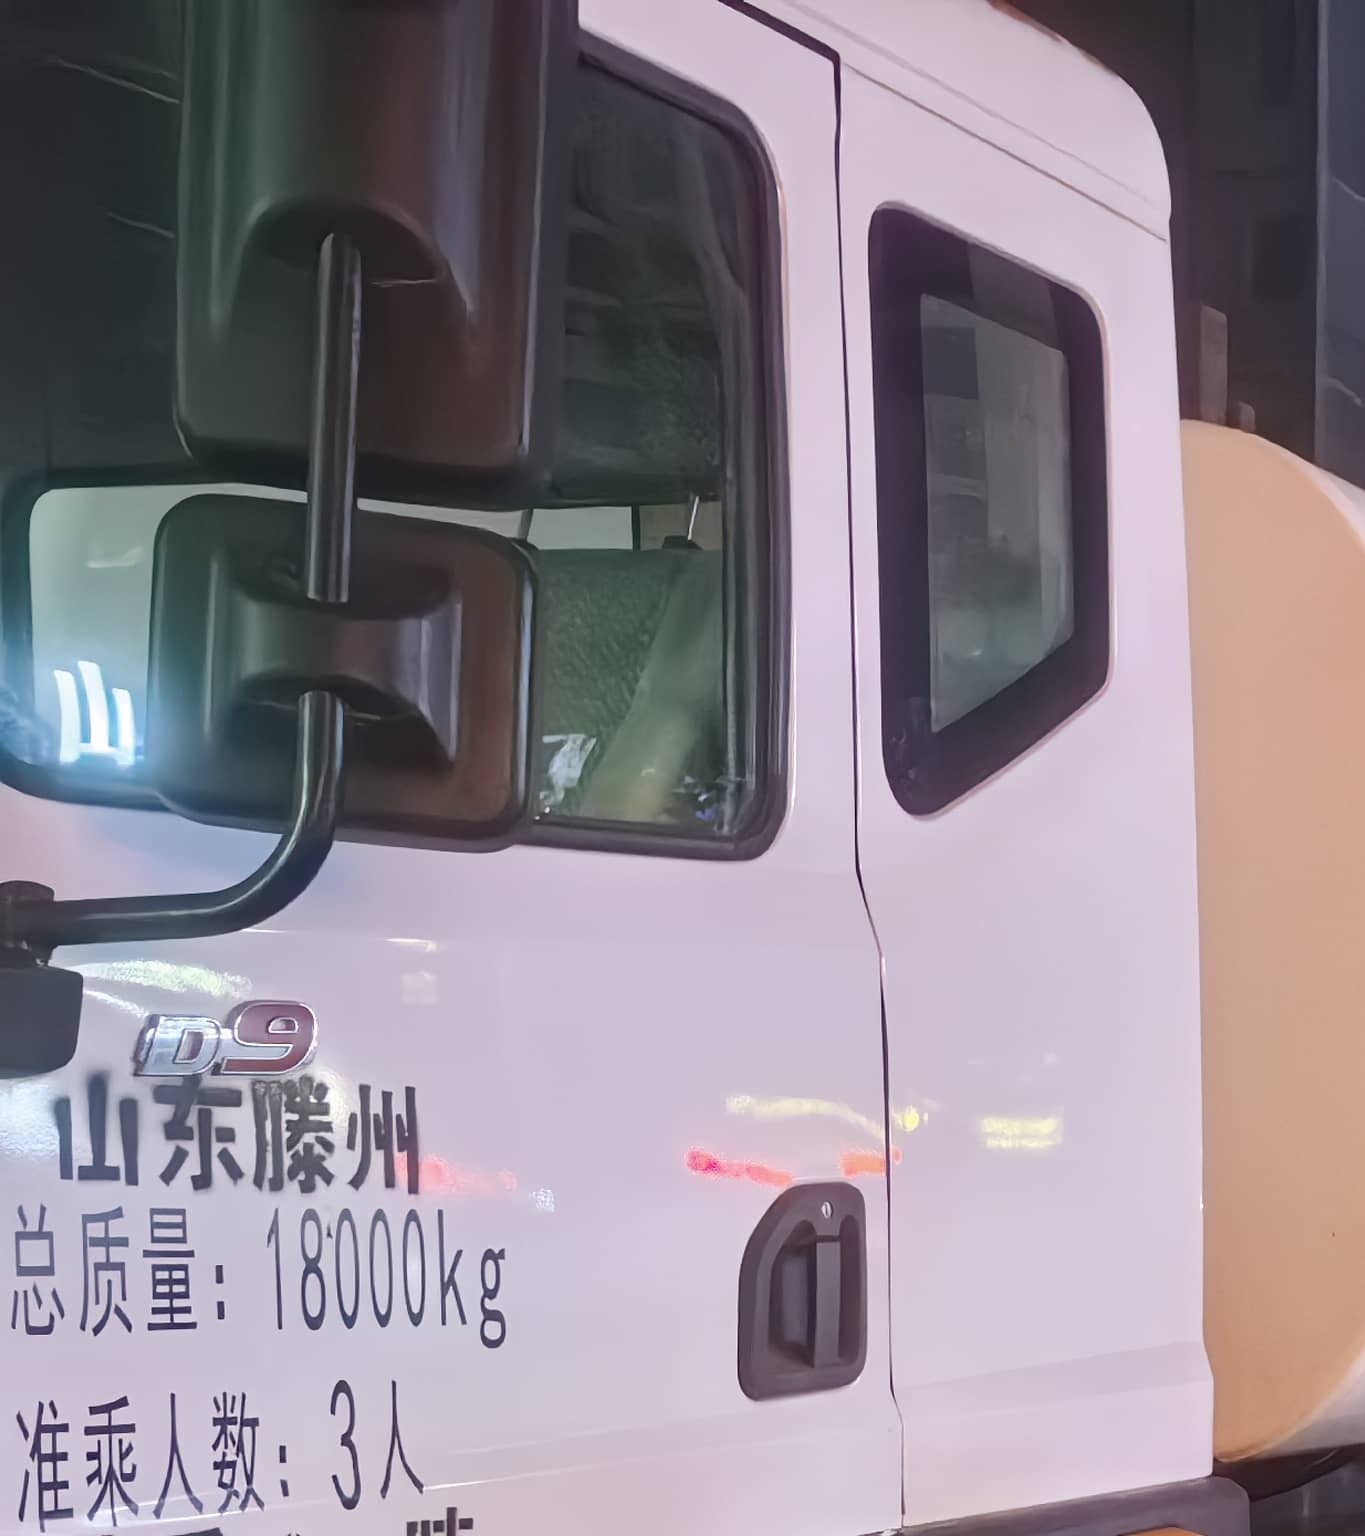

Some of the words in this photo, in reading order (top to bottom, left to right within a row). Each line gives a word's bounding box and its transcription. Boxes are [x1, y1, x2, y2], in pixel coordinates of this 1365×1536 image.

[133, 999, 318, 1078] D9
[54, 1072, 420, 1195] 山东滕州
[10, 1203, 226, 1337] 总质量：
[266, 1206, 507, 1349] 18000kg
[16, 1391, 290, 1532] 准乘人数：
[329, 1379, 425, 1510] 3人
